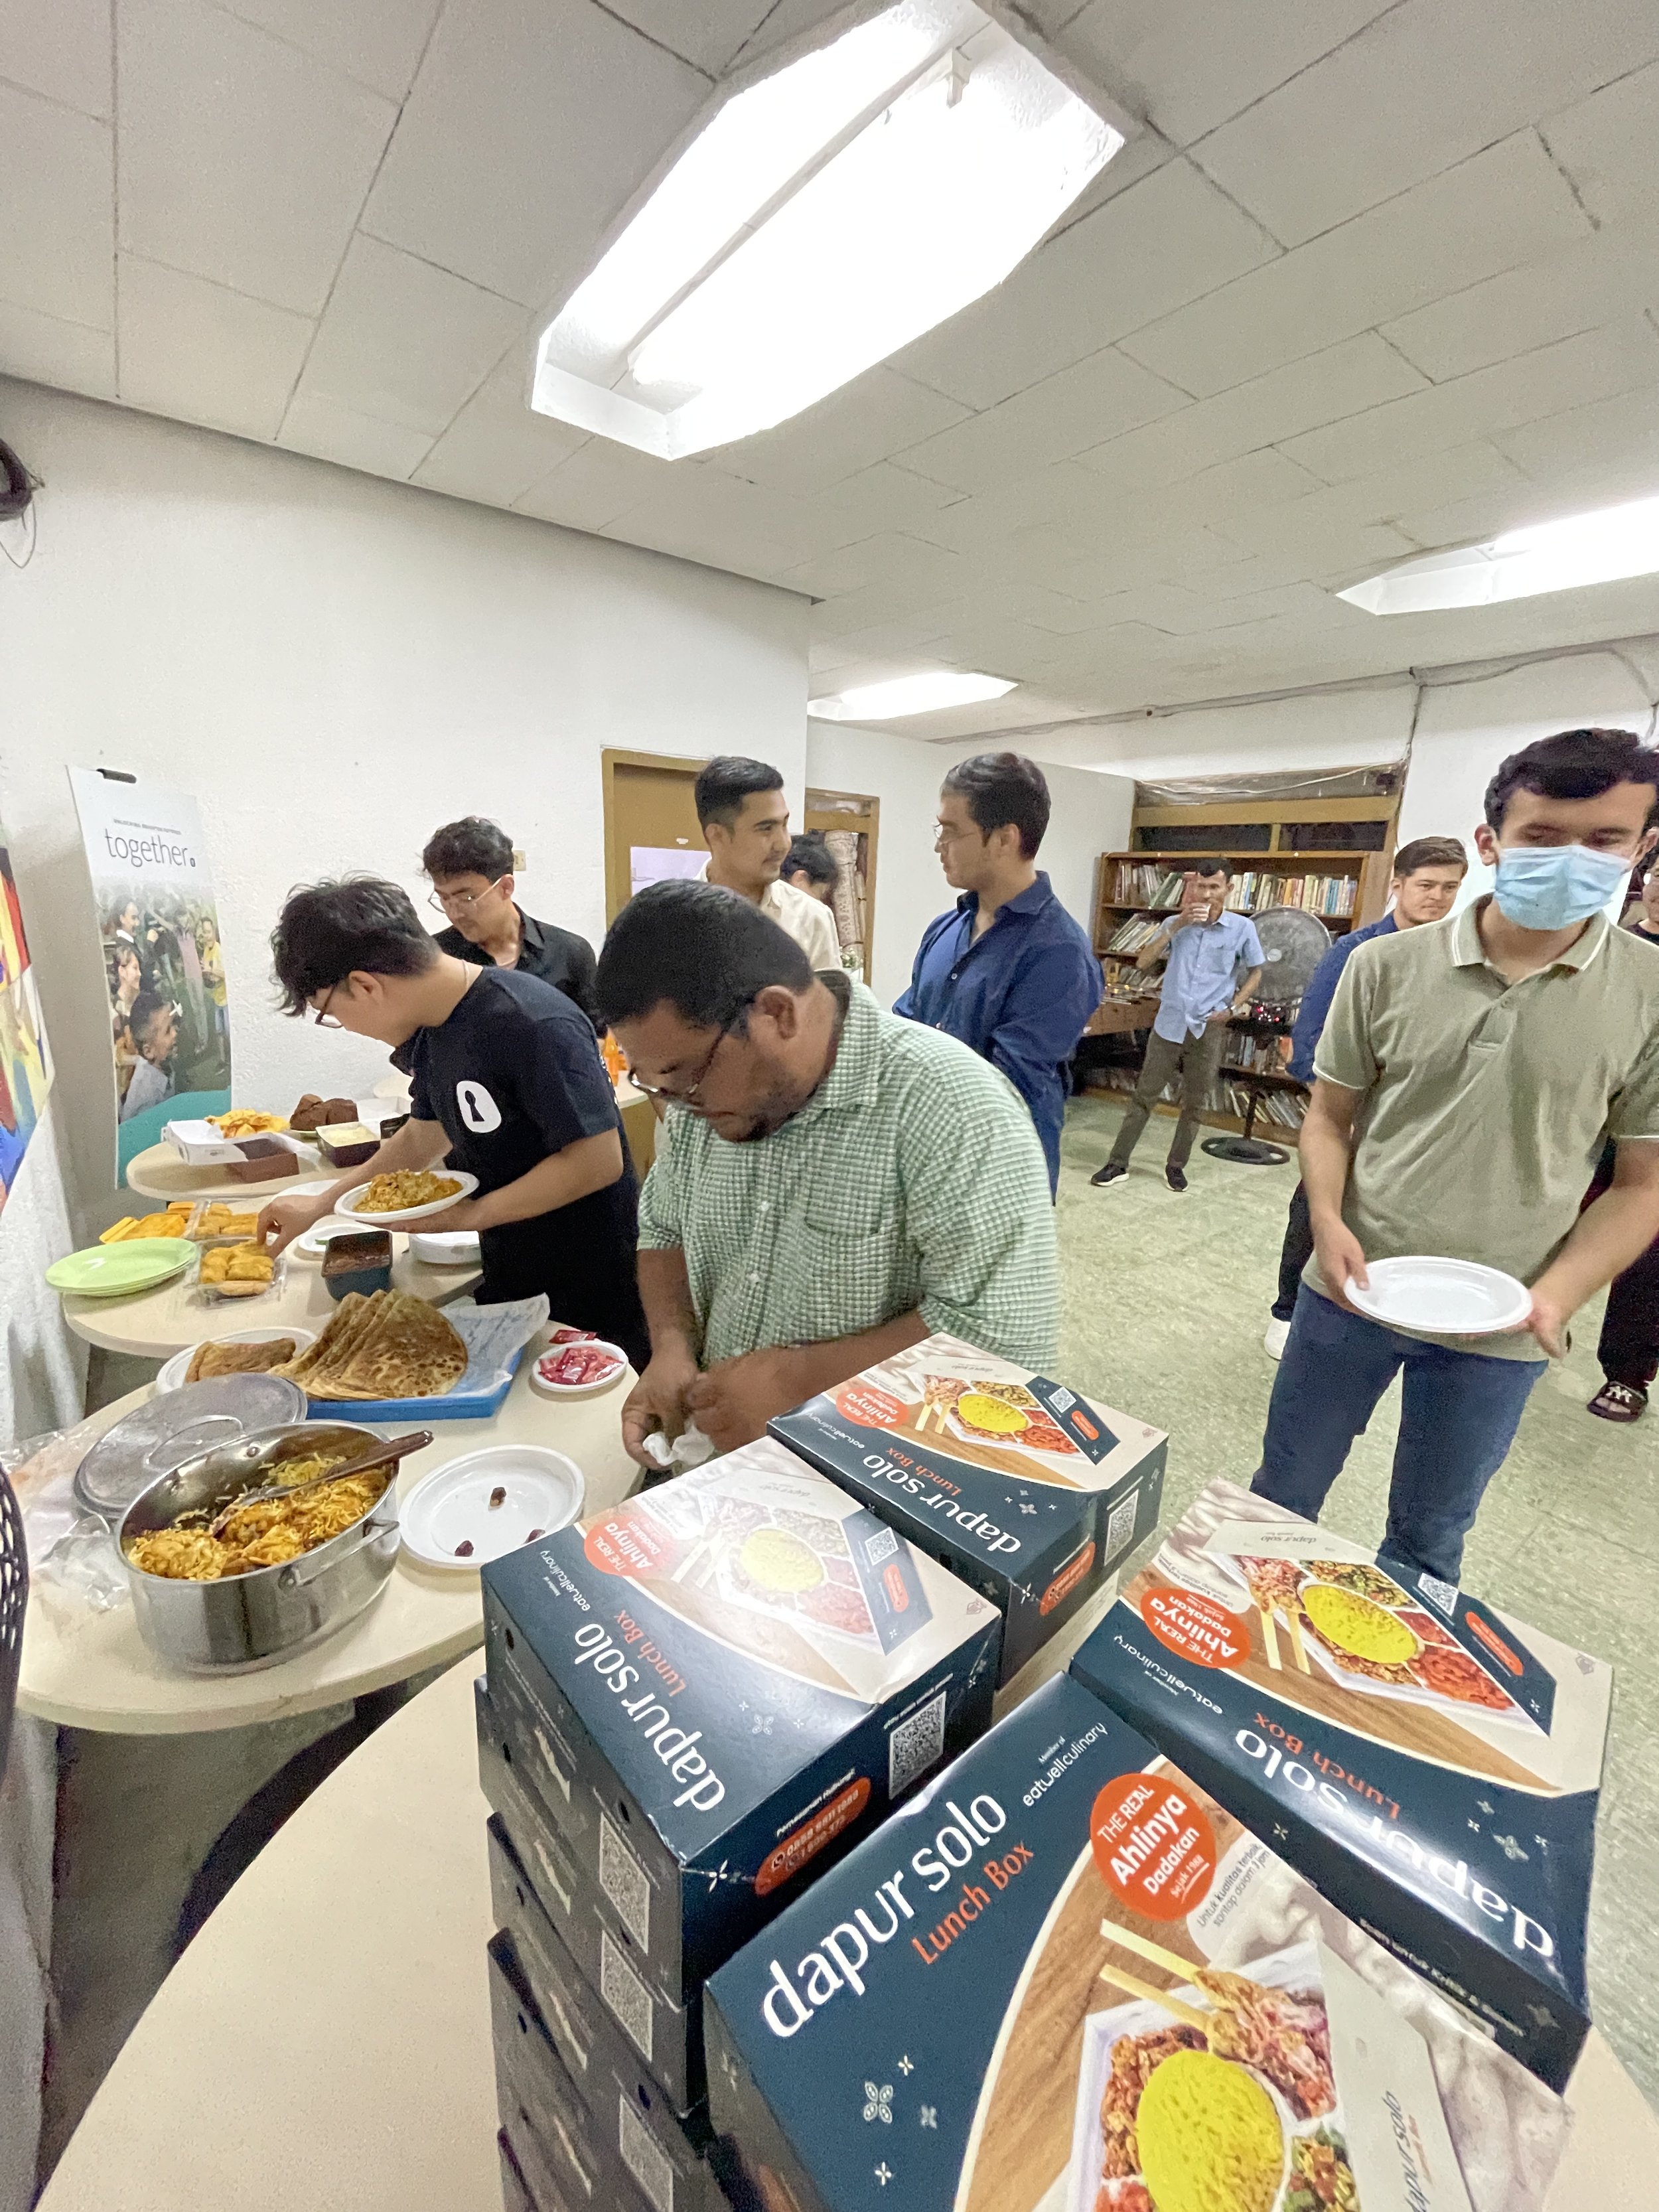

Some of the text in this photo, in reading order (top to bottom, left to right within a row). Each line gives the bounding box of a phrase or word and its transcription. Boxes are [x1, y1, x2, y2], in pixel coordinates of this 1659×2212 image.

[845, 1393, 897, 1423] Ahlinya
[863, 1455, 1021, 1552] dapur solo
[886, 1447, 962, 1496] Lunch Box
[605, 1522, 653, 1568] Ahlinya
[1149, 1597, 1239, 1658] Ahlinya
[1153, 1615, 1213, 1664] THE REAL
[1169, 1595, 1232, 1637] Dadakan
[575, 1623, 639, 1692] solo
[614, 1609, 686, 1697] Lunch Box
[621, 1693, 725, 1811] dapur
[1023, 1722, 1108, 1806] eatwellculinary
[1254, 1712, 1400, 1819] Lunch Box
[1097, 1785, 1155, 1843] THE REAL
[1110, 1794, 1187, 1886] Ahlinya
[1235, 1729, 1555, 1957] dapur solo
[1143, 1827, 1200, 1895] Dadakan
[762, 1870, 914, 2037] dapur
[912, 1795, 1007, 1891] solo
[910, 1841, 1035, 1964] Lunch Box
[1196, 1901, 1220, 1928] Untuk
[1214, 1866, 1242, 1902] kualitas
[1381, 2091, 1410, 2149] solo
